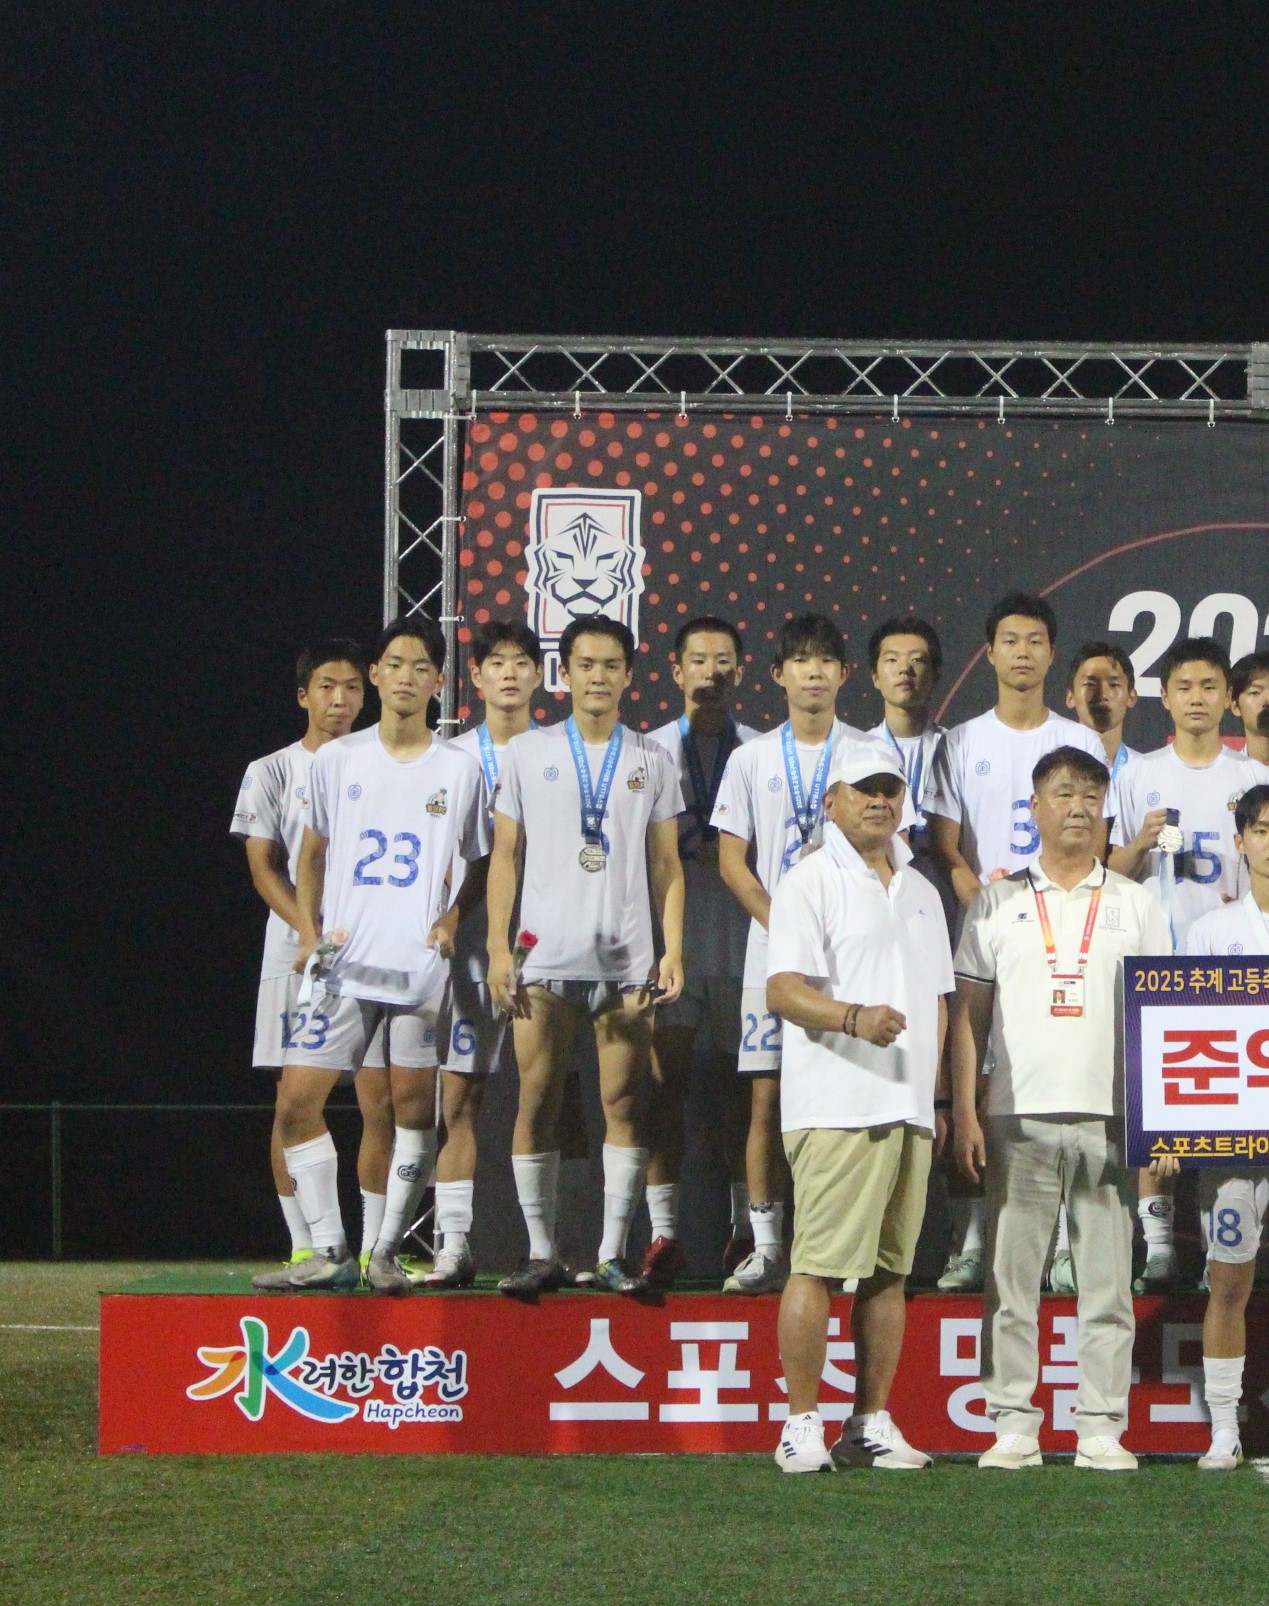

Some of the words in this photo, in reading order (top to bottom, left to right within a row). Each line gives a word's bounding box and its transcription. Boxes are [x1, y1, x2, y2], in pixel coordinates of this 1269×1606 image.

[353, 829, 422, 888] 23
[1135, 969, 1185, 992] 2025
[1189, 967, 1223, 994] 추계
[452, 1018, 477, 1056] 6
[742, 1013, 783, 1052] 22
[1209, 1208, 1243, 1248] 18
[378, 1347, 465, 1400] 합천
[366, 1403, 460, 1427] Hapcheon
